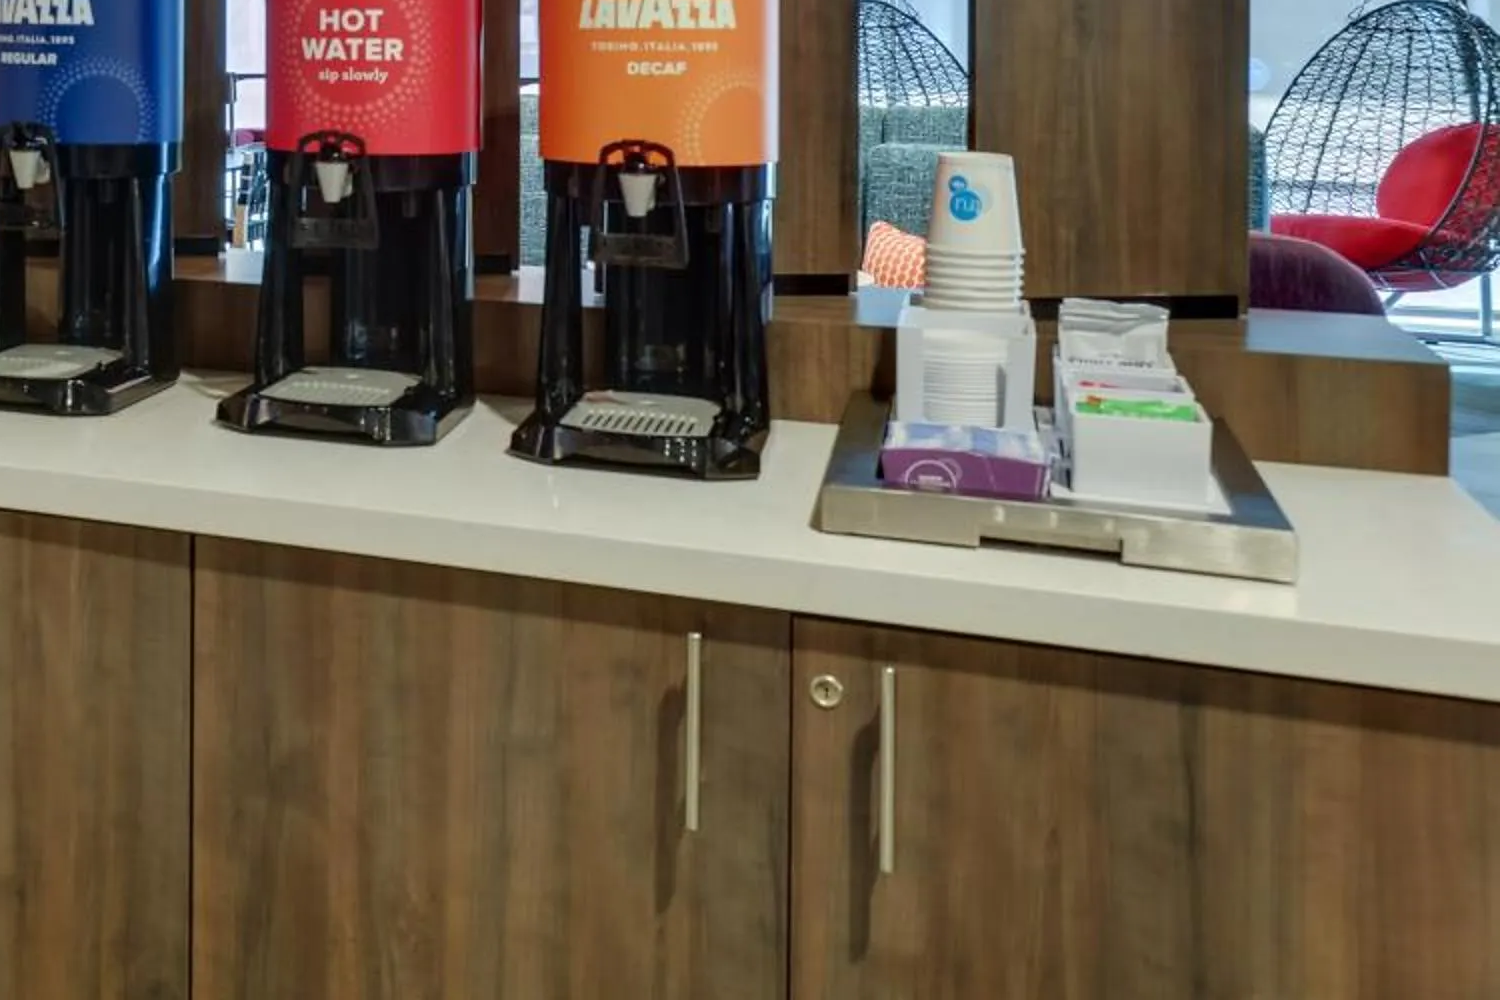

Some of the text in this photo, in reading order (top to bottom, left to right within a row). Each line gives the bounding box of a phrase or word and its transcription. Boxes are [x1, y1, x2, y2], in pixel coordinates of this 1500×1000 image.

[318, 7, 384, 32] HOT
[301, 37, 404, 61] WATER
[0, 51, 58, 66] REGULAR
[318, 67, 389, 84] sip slowly
[627, 61, 687, 76] DECAF
